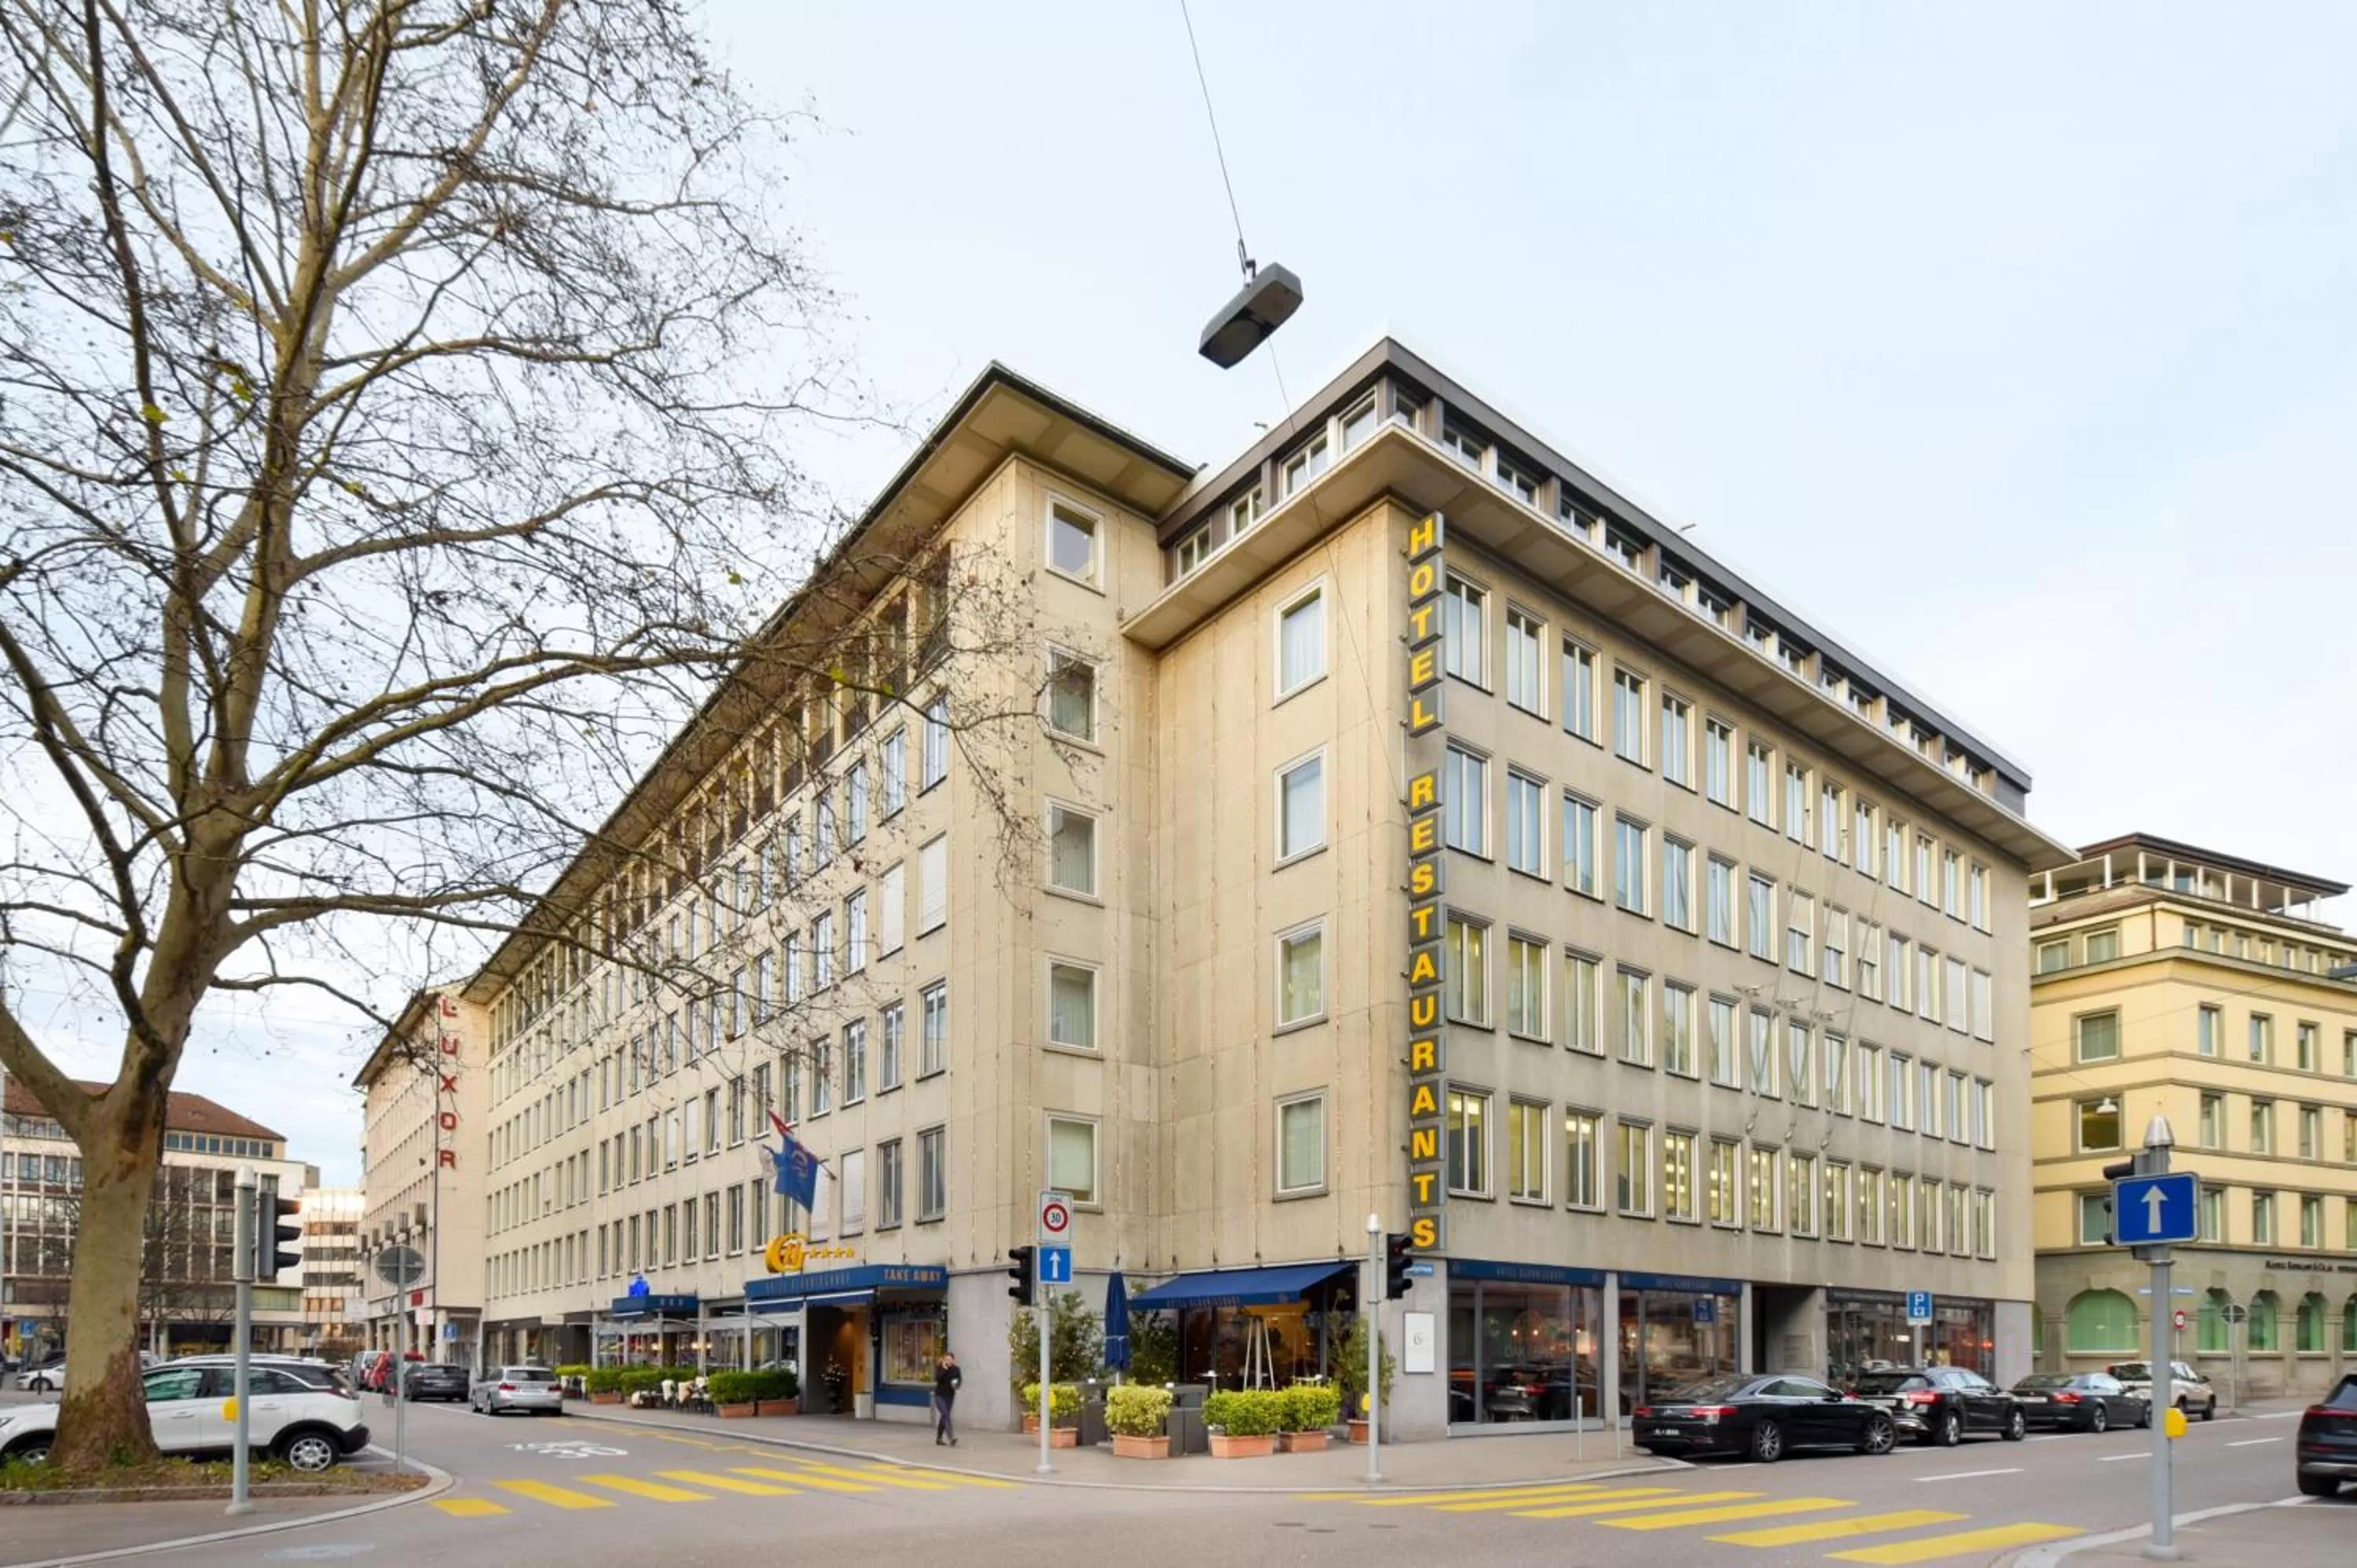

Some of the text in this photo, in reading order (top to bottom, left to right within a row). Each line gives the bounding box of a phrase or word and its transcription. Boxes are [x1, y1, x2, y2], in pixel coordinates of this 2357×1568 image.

[1410, 518, 1435, 729] HOTEL
[439, 999, 458, 1169] LUXOR
[1410, 776, 1437, 1251] RESTAURANTS
[884, 1269, 941, 1283] TAKE AWAY
[1050, 1212, 1061, 1223] 30
